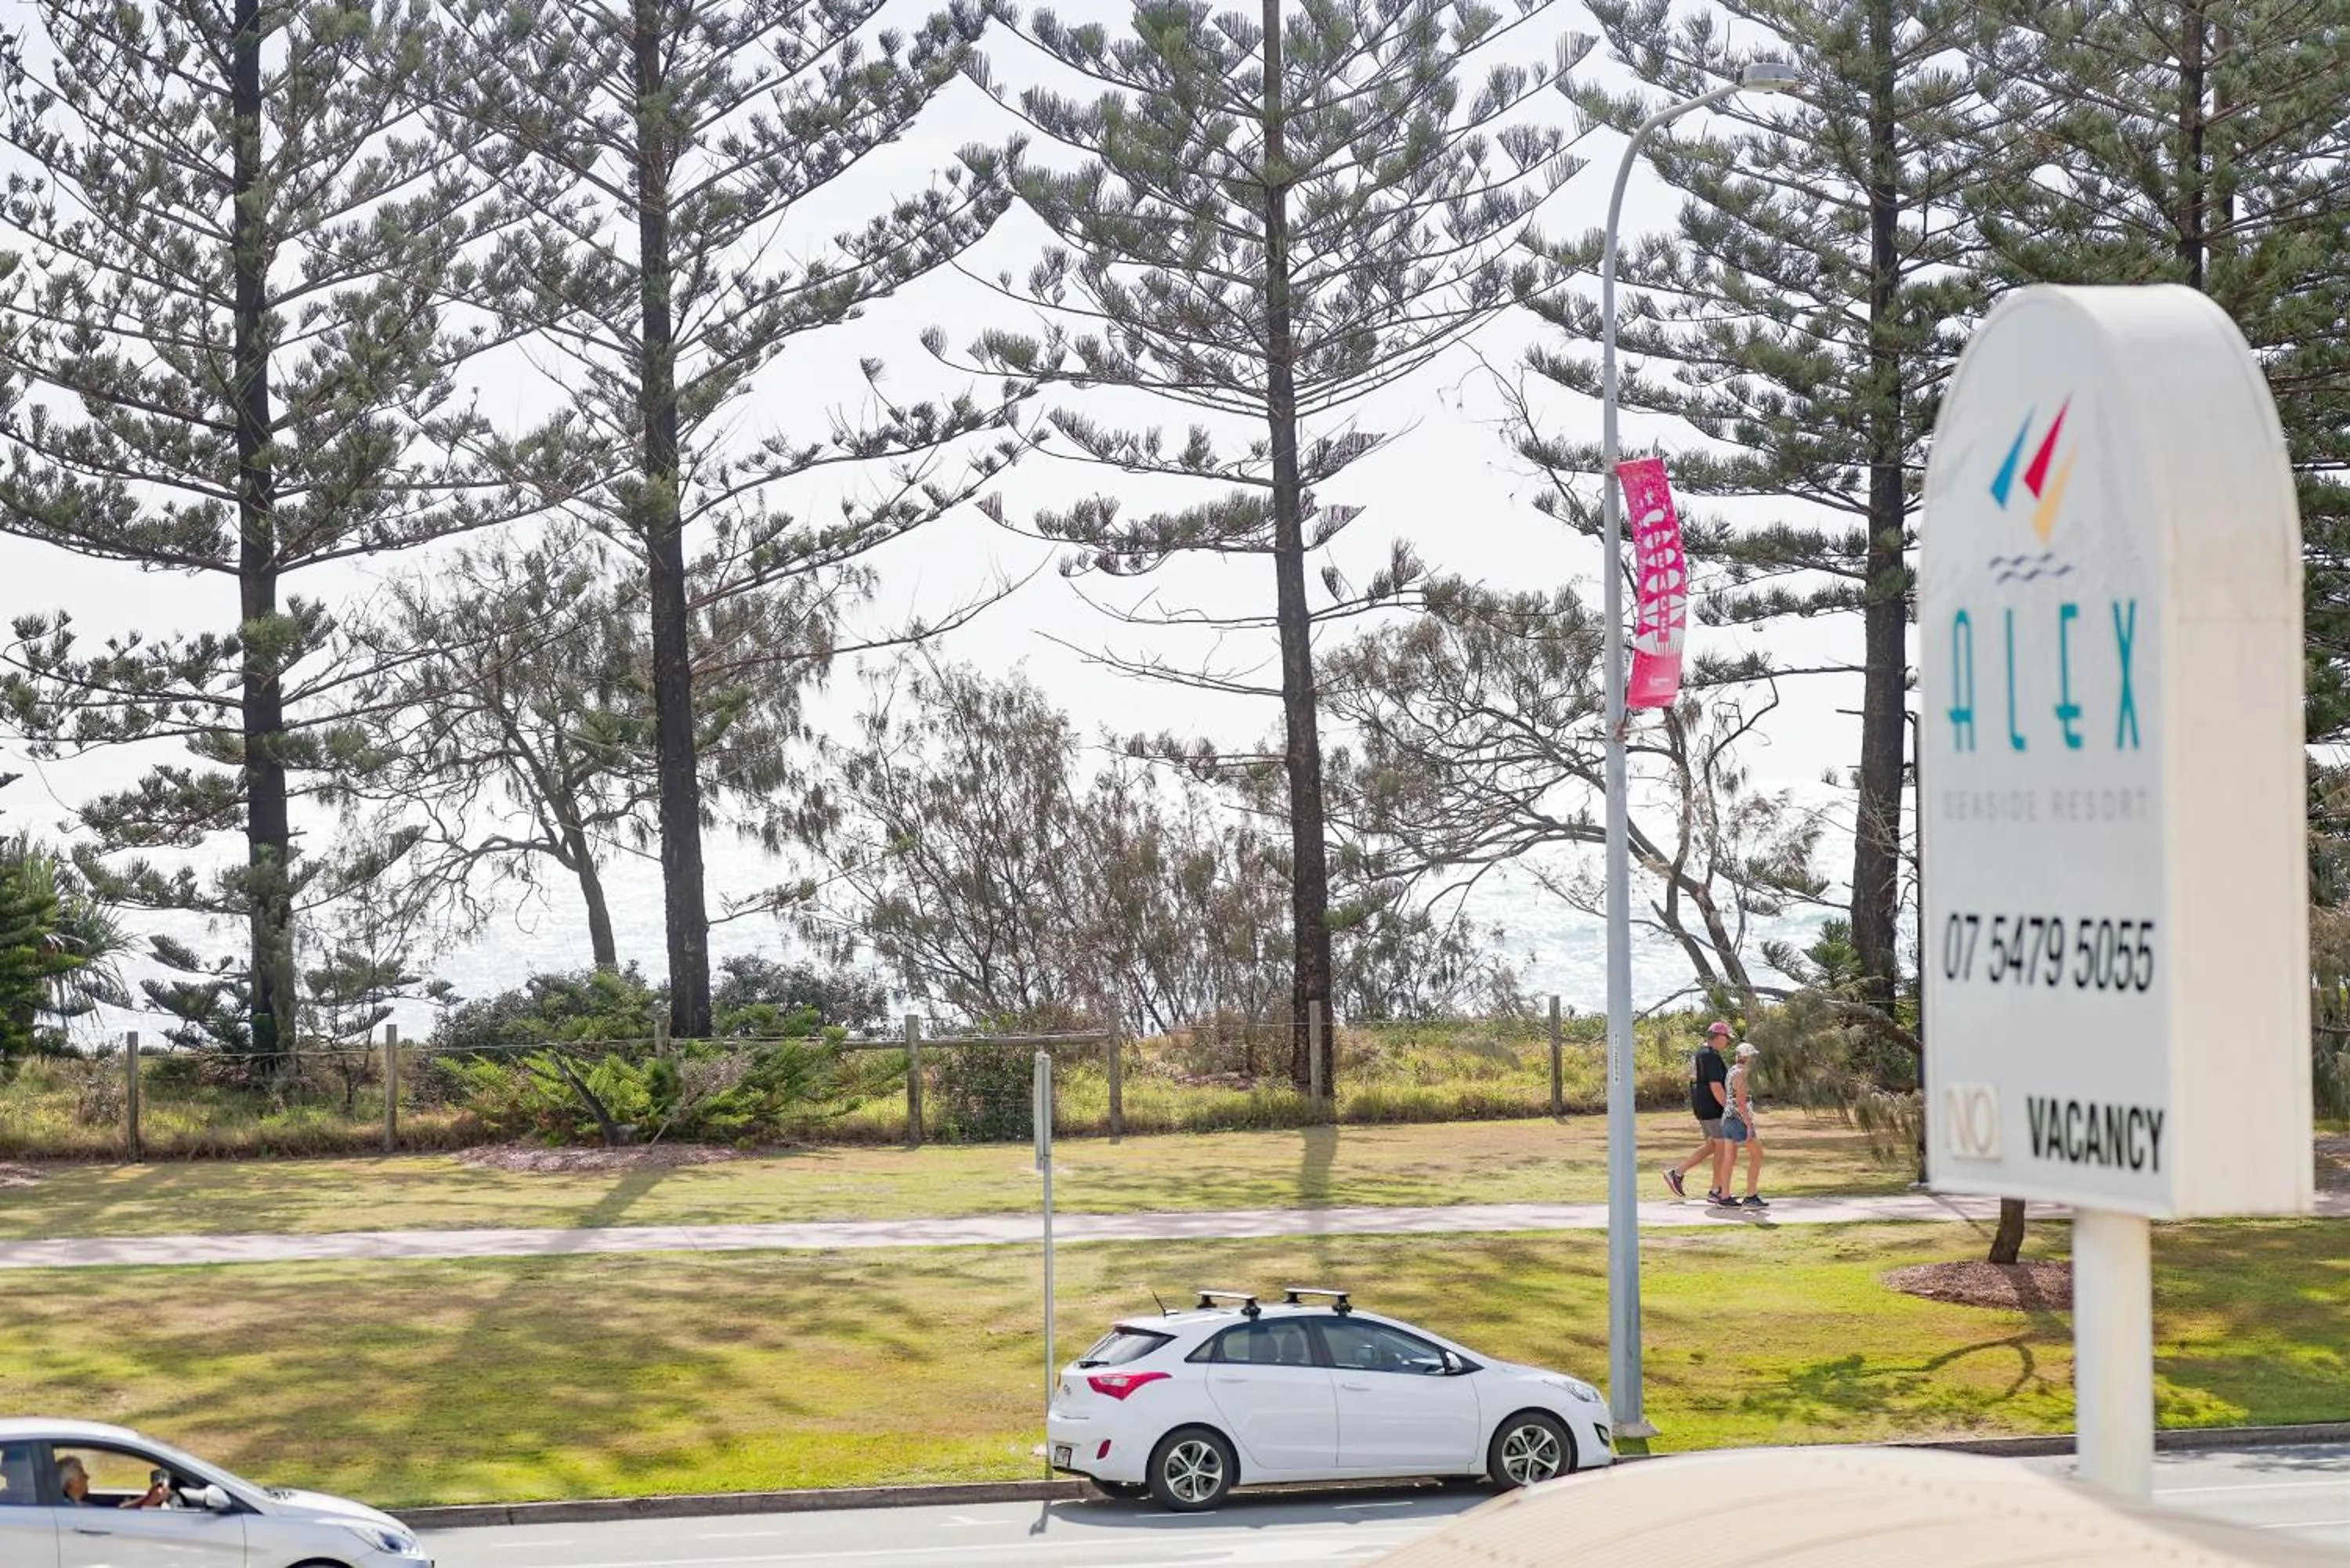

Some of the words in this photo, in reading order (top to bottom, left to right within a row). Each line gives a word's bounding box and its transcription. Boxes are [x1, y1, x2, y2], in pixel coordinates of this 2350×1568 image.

[1947, 598, 2140, 753] ALEX
[1943, 789, 2038, 822] SEASIDE
[2052, 788, 2149, 822] RESORT
[1944, 912, 1980, 982] 07
[1988, 914, 2065, 988] 5479
[2074, 918, 2154, 992] 5055
[1945, 1087, 1996, 1154] NO
[2027, 1095, 2164, 1173] VACANCY
